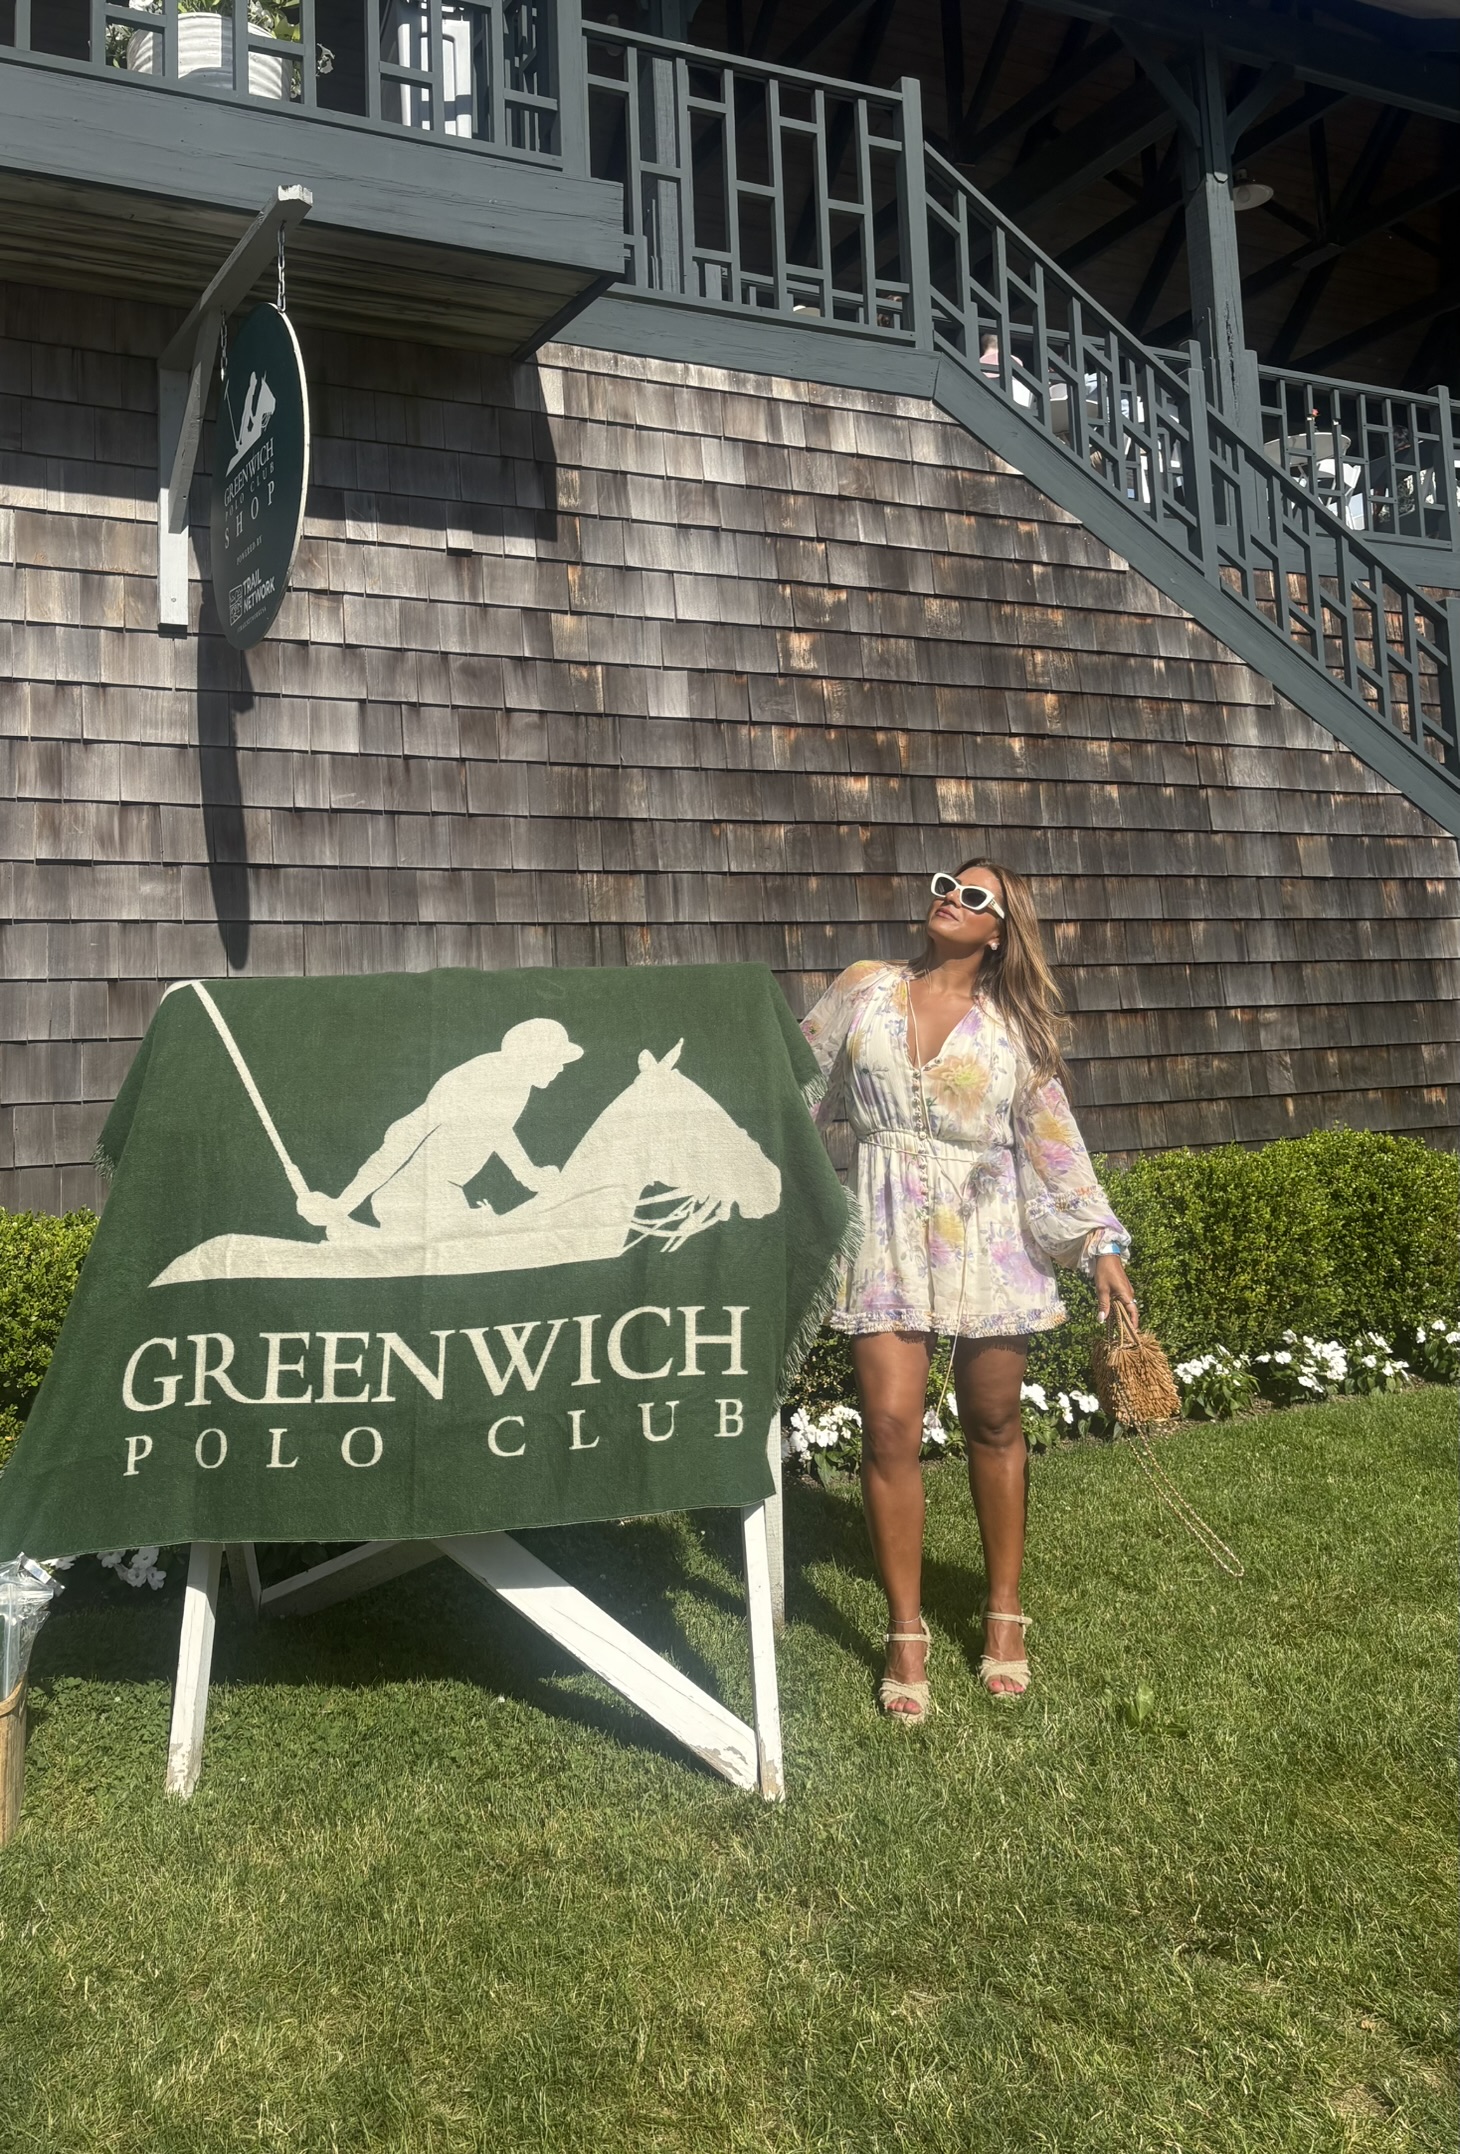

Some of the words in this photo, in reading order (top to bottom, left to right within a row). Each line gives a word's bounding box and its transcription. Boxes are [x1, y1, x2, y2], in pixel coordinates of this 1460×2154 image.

[224, 437, 274, 507] GREENWICH
[225, 492, 245, 521] POLO
[250, 461, 275, 493] CLUB
[224, 480, 275, 549] SHOP
[243, 568, 262, 596] TRAIL
[243, 576, 275, 613] NETWORK
[122, 1305, 750, 1412] GREENWICH
[123, 1426, 384, 1477] POLO
[487, 1398, 744, 1457] CLUB
